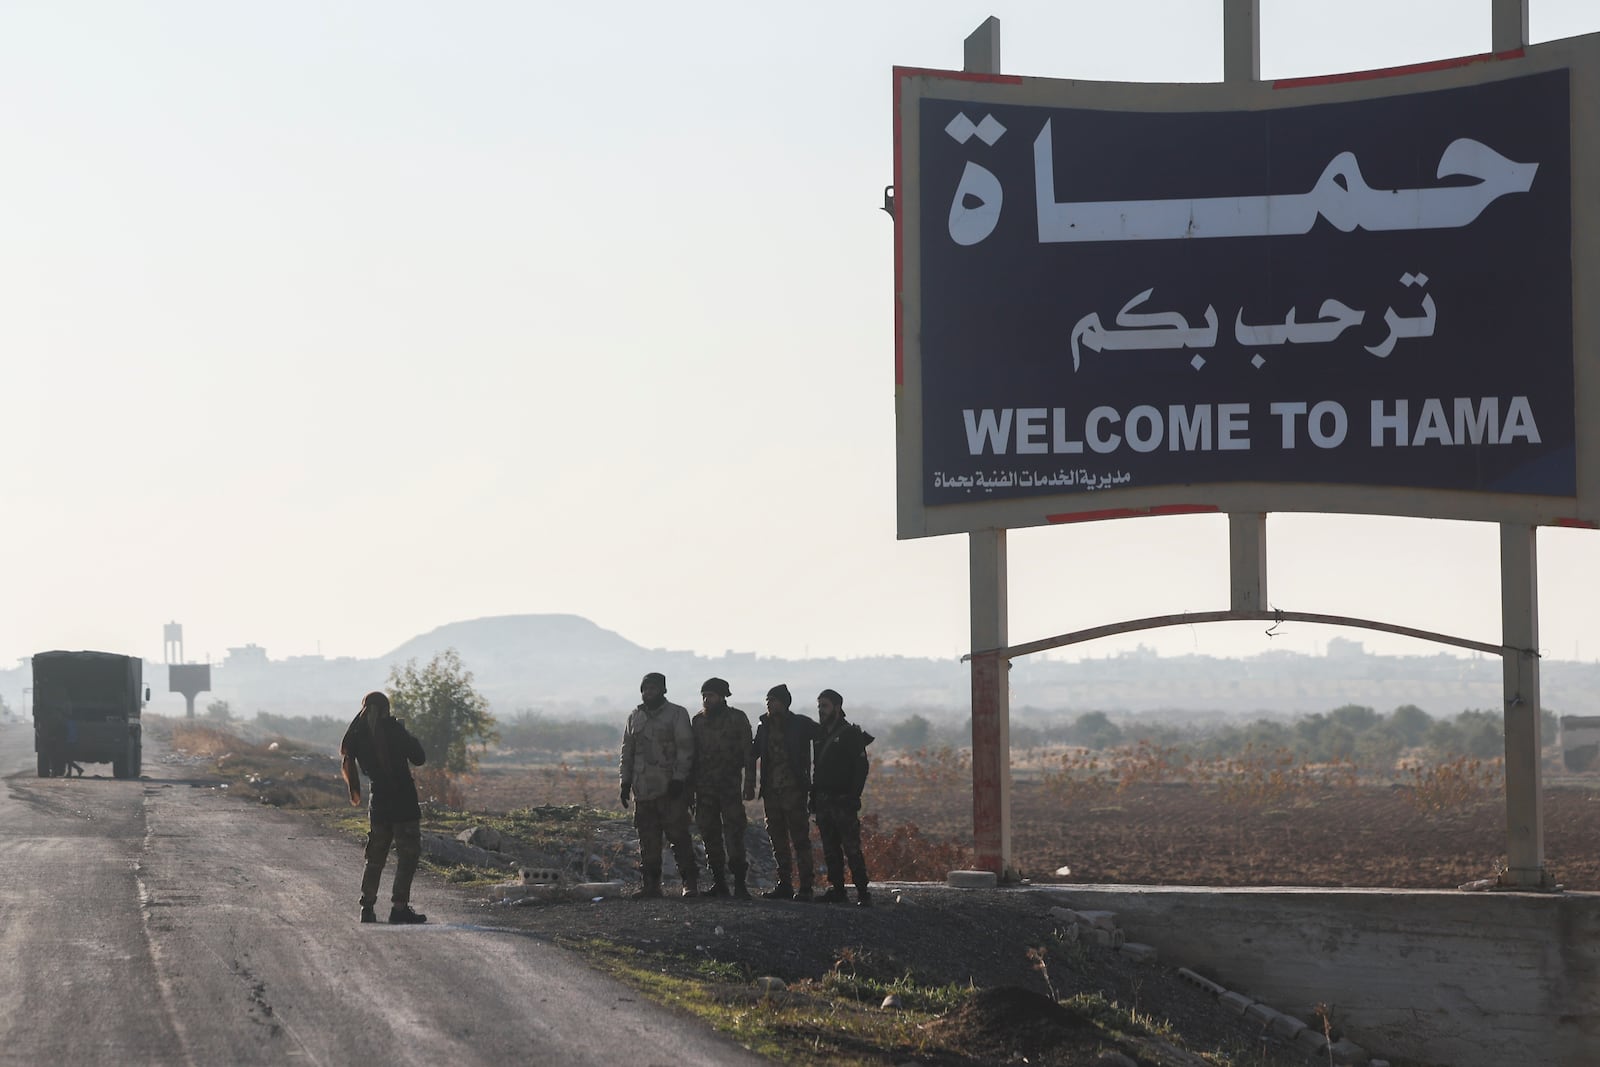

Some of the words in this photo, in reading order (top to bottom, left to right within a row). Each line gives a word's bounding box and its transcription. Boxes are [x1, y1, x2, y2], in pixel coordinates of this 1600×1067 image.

[944, 111, 1539, 246] حماة
[1070, 287, 1219, 373] بكم
[1234, 271, 1437, 369] ترحب
[962, 403, 1252, 456] WELCOME
[1270, 400, 1348, 450] TO
[1370, 395, 1542, 448] HAMA
[934, 471, 974, 493] بحماة
[975, 470, 1018, 493] الفنية
[1019, 469, 1079, 487] الخدمات
[1079, 469, 1131, 490] مديرية
